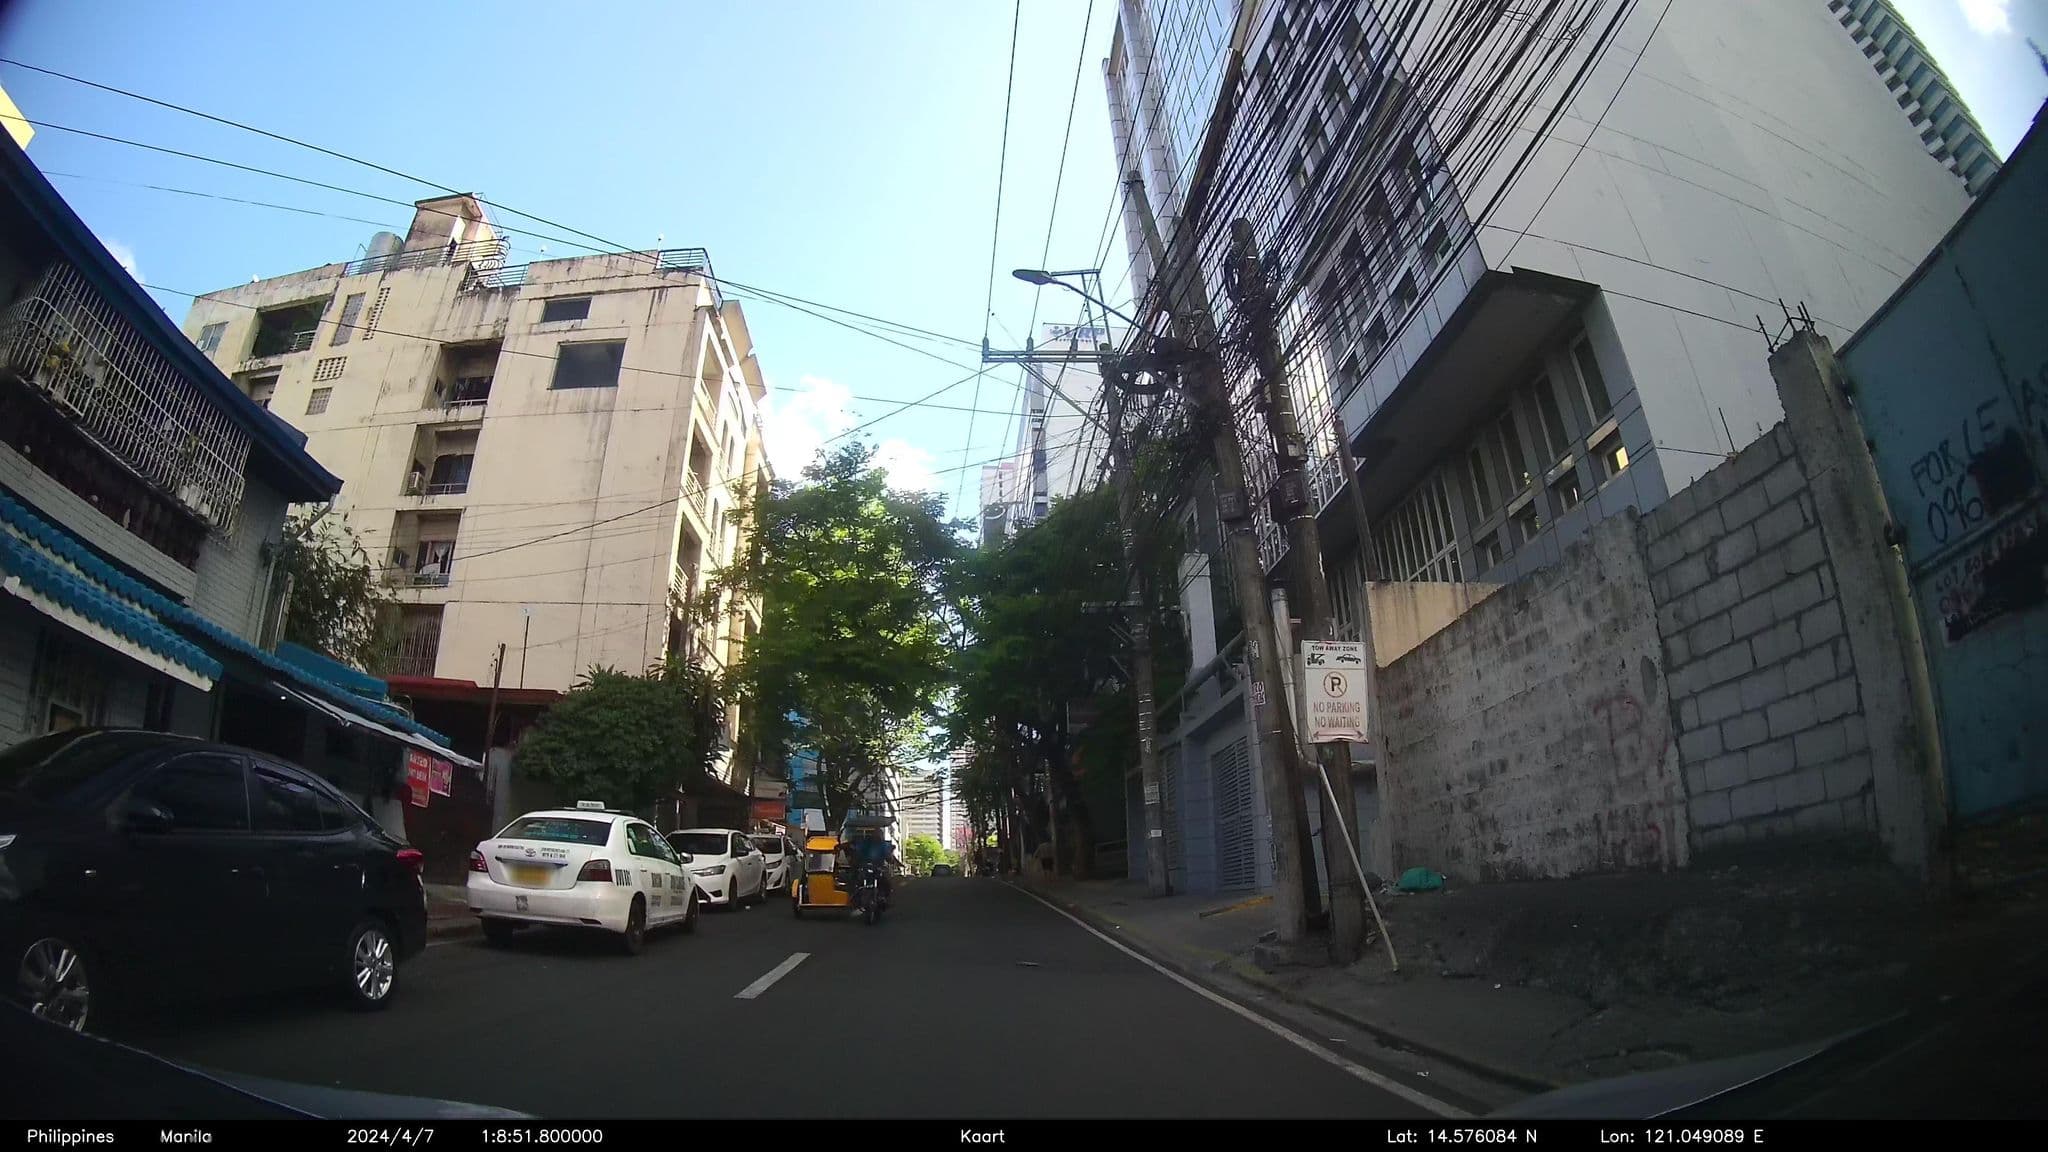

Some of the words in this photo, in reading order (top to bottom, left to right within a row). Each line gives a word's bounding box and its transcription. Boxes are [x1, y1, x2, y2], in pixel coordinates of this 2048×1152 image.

[1910, 439, 1965, 498] FOR
[1330, 676, 1341, 692] P
[1313, 702, 1325, 713] NO
[1326, 702, 1361, 713] PARKING
[1314, 716, 1326, 728] NO
[1328, 716, 1360, 728] WAITING
